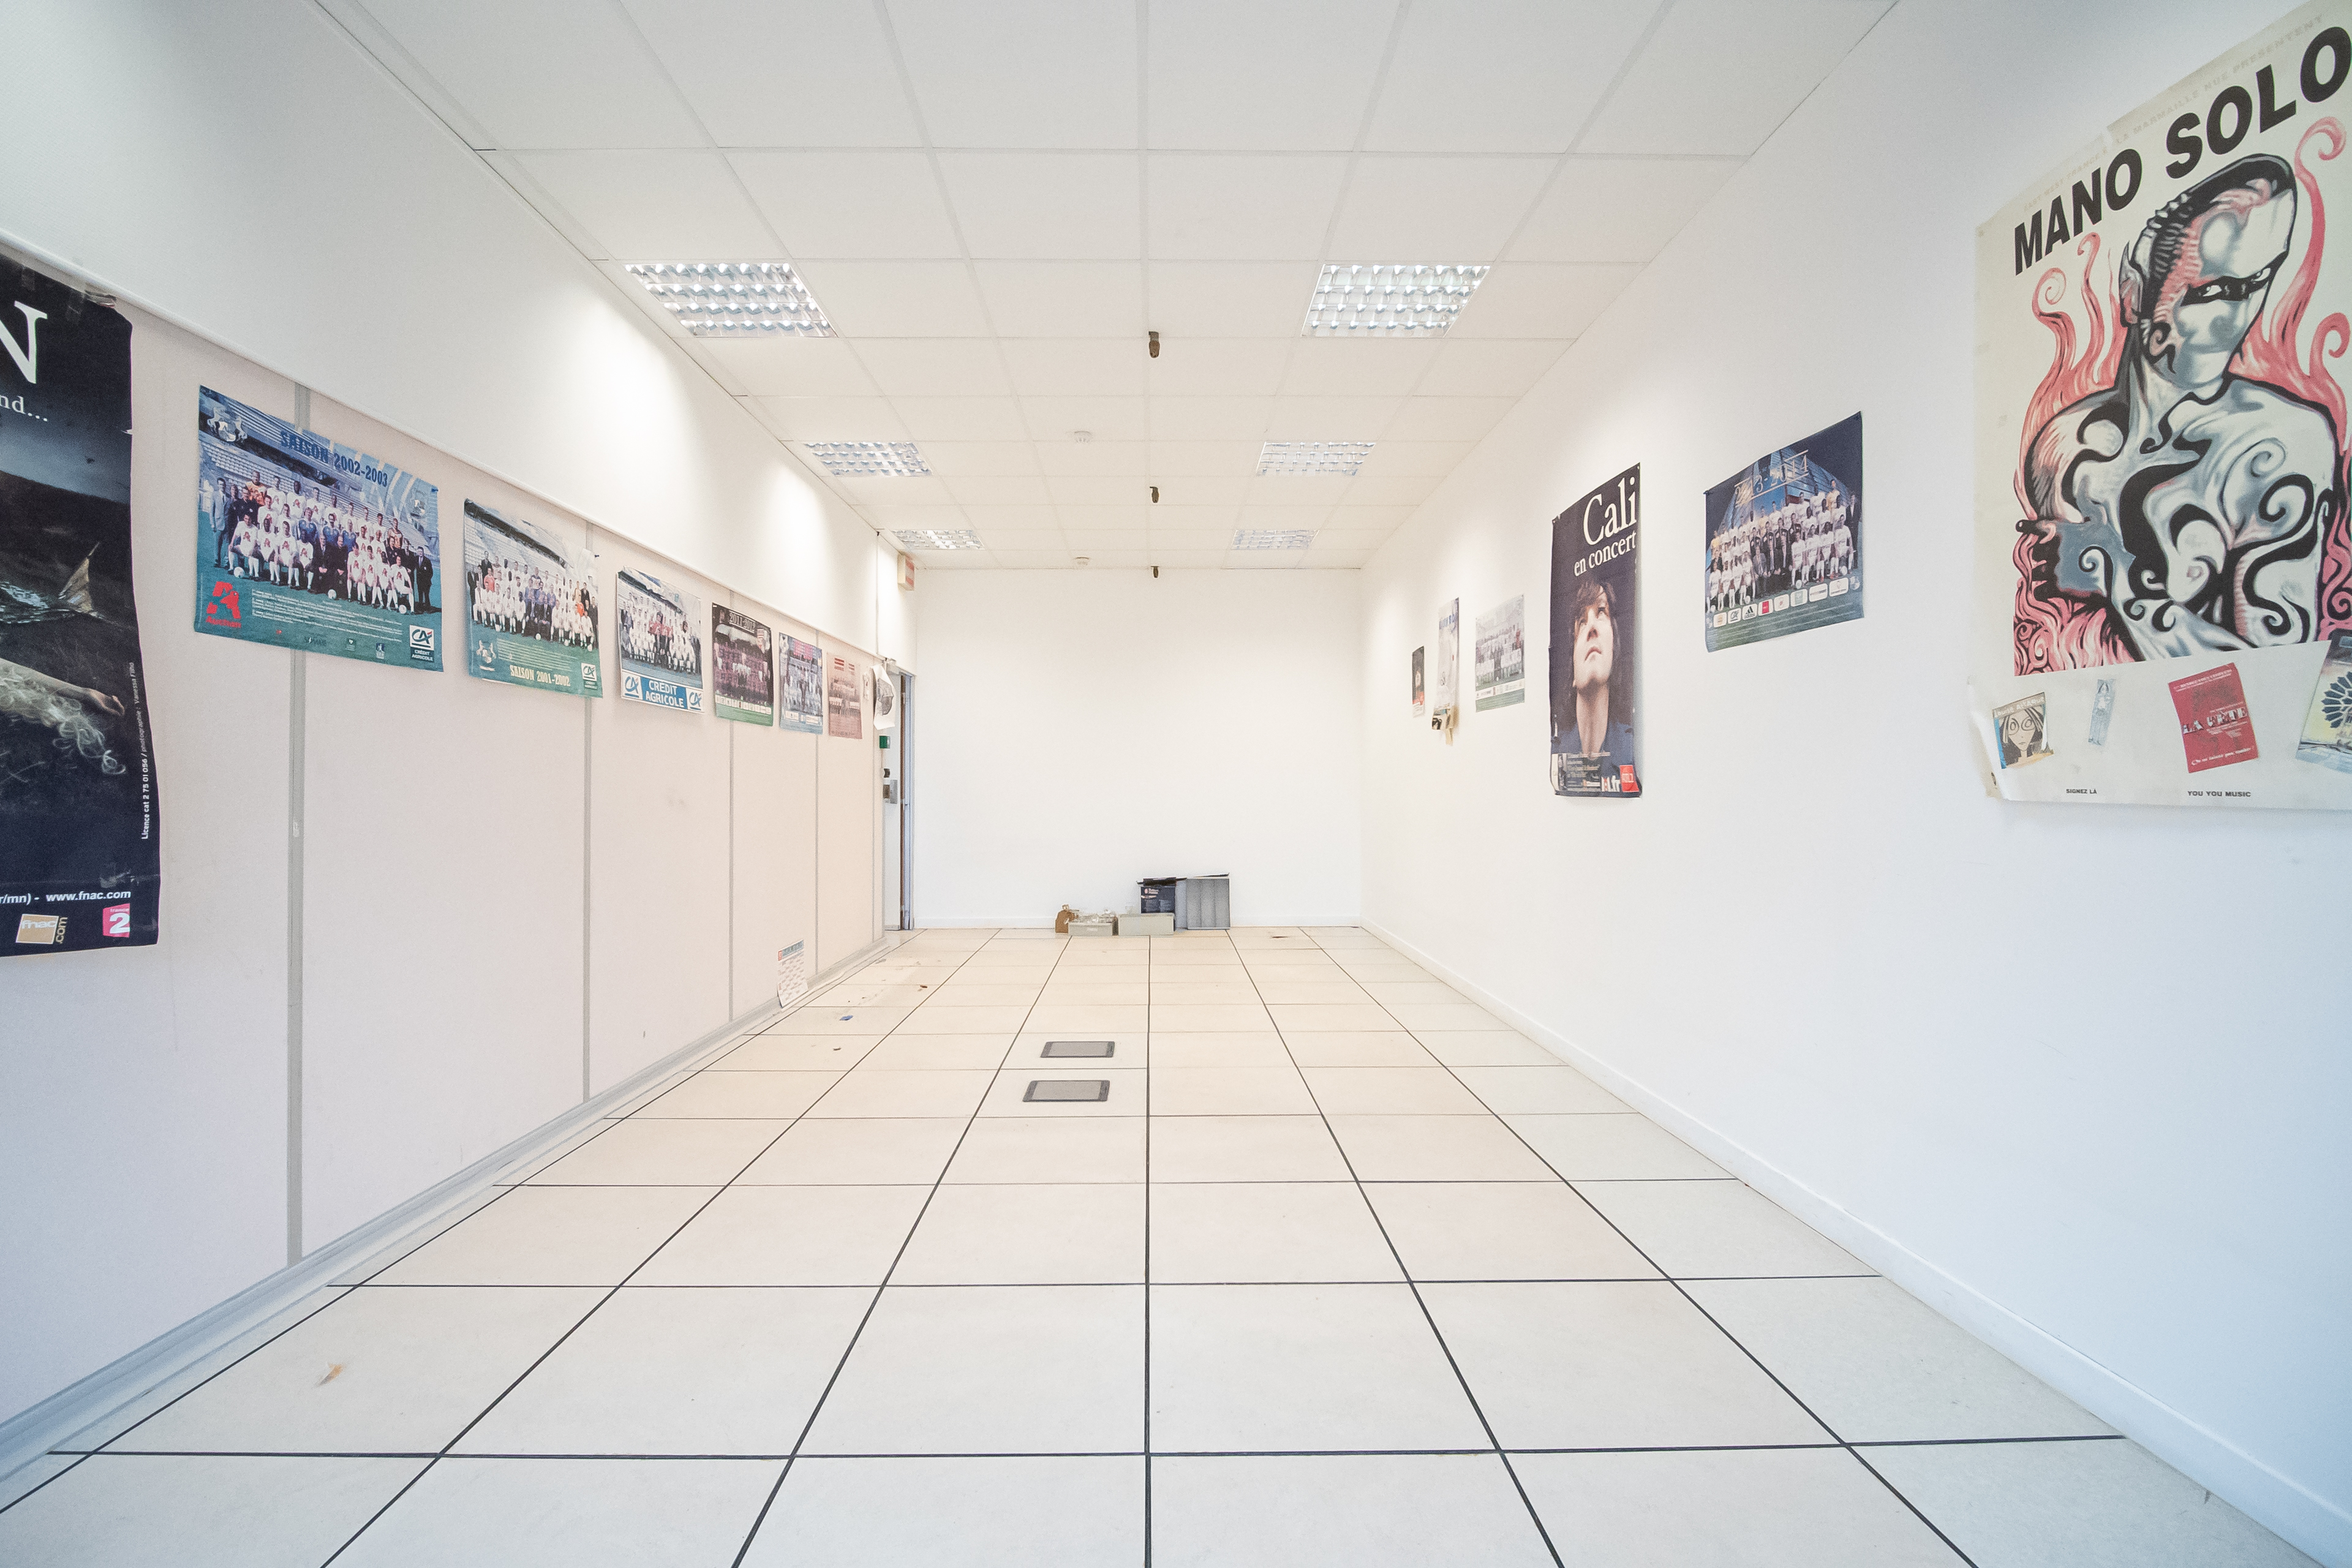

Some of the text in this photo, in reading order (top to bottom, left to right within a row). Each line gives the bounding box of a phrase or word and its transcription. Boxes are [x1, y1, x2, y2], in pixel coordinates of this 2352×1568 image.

[2015, 26, 2352, 276] MANO SOLO
[281, 430, 388, 487] SAISON 2002-2003
[1583, 477, 1637, 545] Cali
[1574, 530, 1637, 576] en concert
[510, 665, 535, 681] SAISON
[537, 671, 571, 687] 2001-2002
[131, 678, 140, 704] Vanessa
[646, 690, 685, 707] AGRICOLE
[143, 784, 149, 793] 75
[141, 814, 150, 840] Licence
[46, 891, 131, 902] www.fnac.com
[21, 920, 57, 929] fnac
[56, 917, 67, 944] .com
[109, 913, 130, 933] 2
